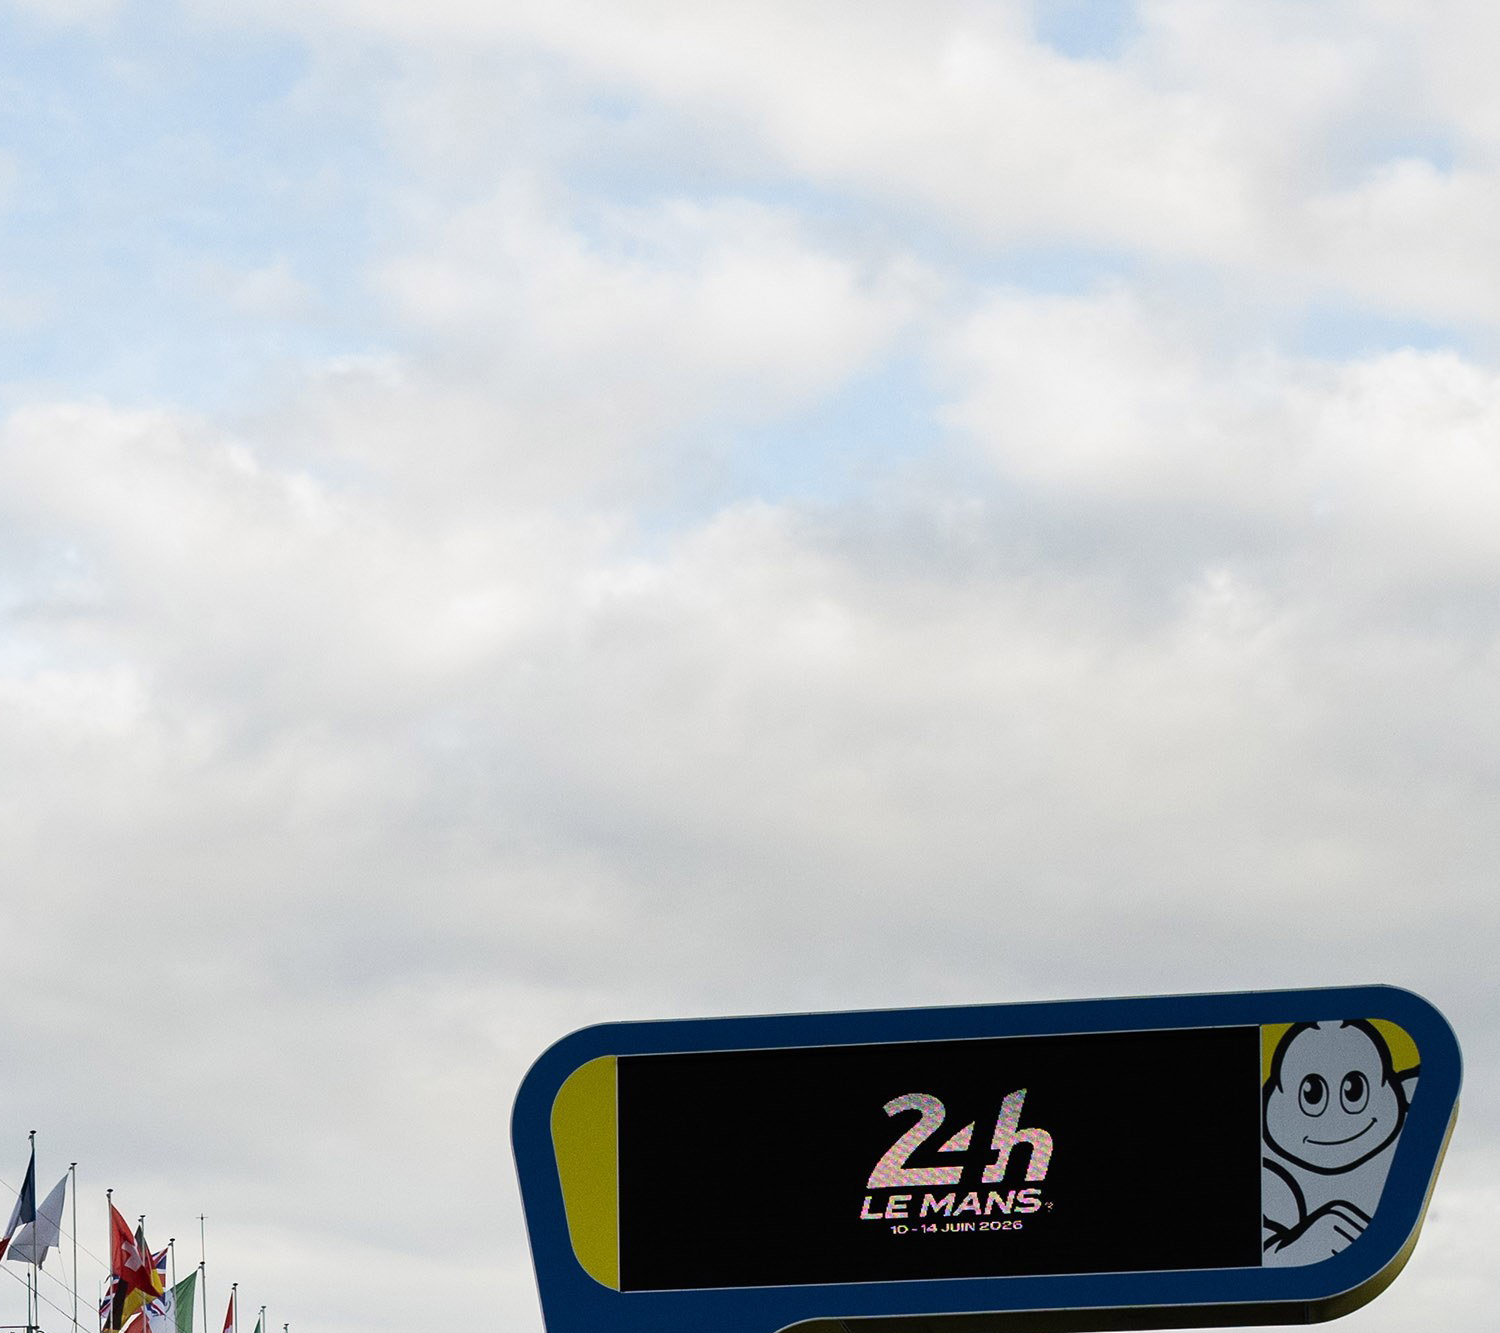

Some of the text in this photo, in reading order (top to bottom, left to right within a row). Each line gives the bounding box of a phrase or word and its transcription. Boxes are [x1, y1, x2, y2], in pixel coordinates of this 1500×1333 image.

[867, 1088, 1054, 1188] 24h
[860, 1188, 1042, 1220] LE MANS
[890, 1223, 908, 1235] 10
[921, 1223, 937, 1235] 14
[940, 1221, 976, 1233] JUIN
[979, 1219, 1023, 1232] 2026
